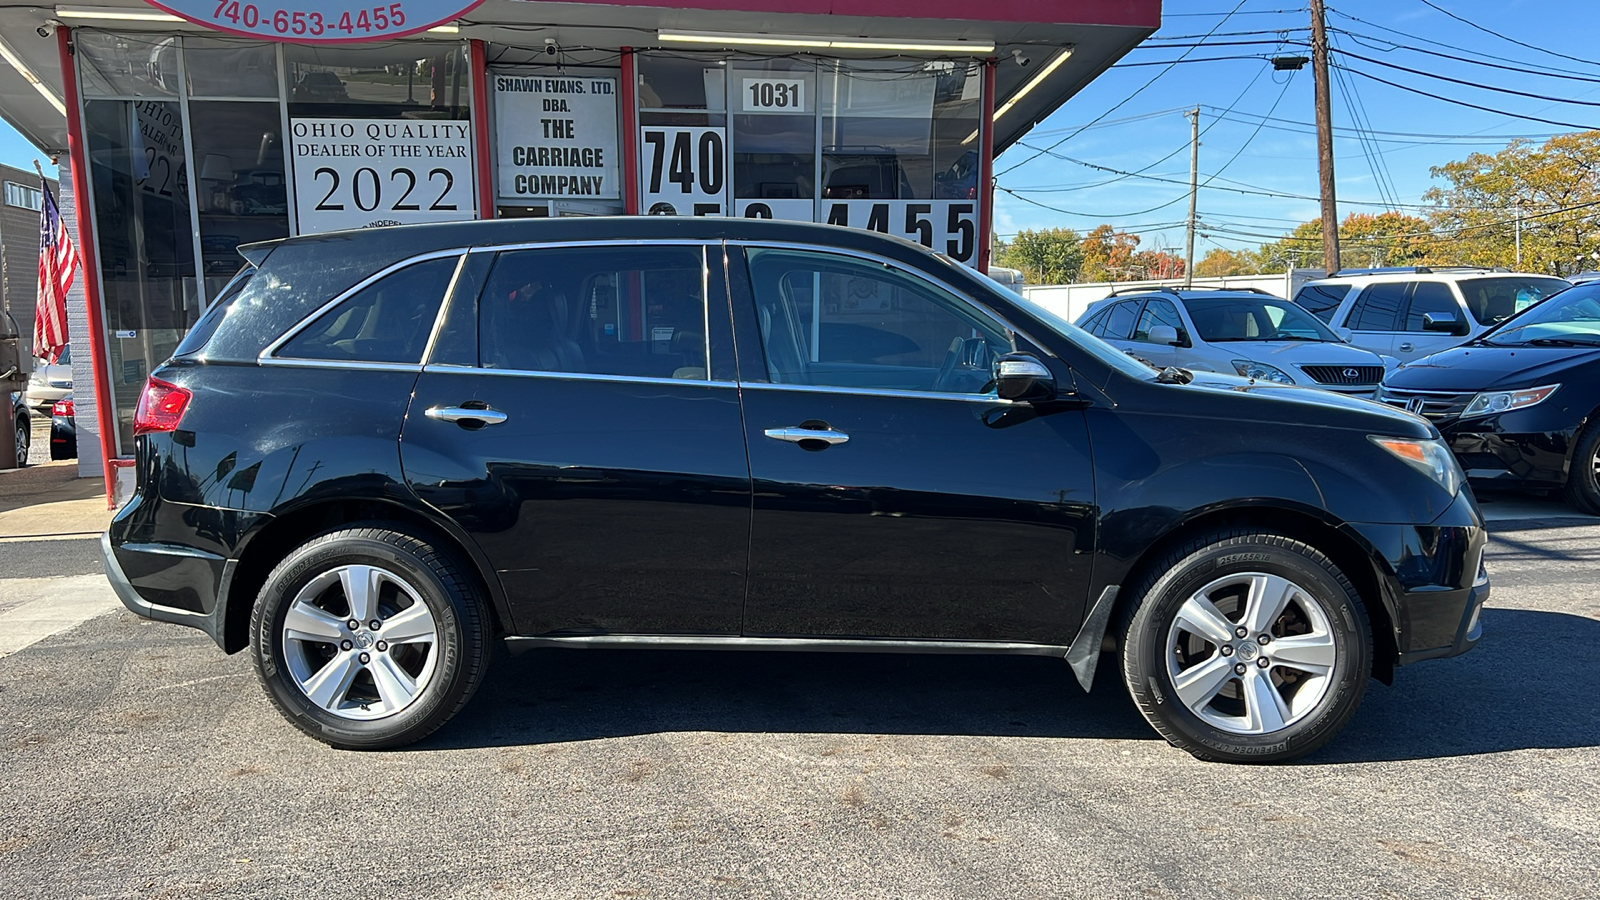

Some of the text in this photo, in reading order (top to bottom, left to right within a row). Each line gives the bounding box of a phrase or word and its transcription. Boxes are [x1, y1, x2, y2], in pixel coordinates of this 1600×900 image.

[213, 0, 406, 35] 740-653-4455
[497, 78, 614, 95] SHAWN EVANS. LTD.
[749, 83, 799, 107] 1031
[542, 98, 571, 112] DBA.
[293, 122, 468, 141] OHIO QUALITY
[541, 119, 574, 139] THE
[297, 143, 467, 158] DEALER OF THE YEAR
[512, 146, 604, 168] CARRIAGE
[644, 131, 723, 195] 740
[314, 167, 458, 212] 2022
[514, 174, 604, 195] COMPANY
[369, 219, 402, 229] INDEPE
[1220, 553, 1272, 566] 255/55R18
[1232, 744, 1285, 755] DEFENDER
